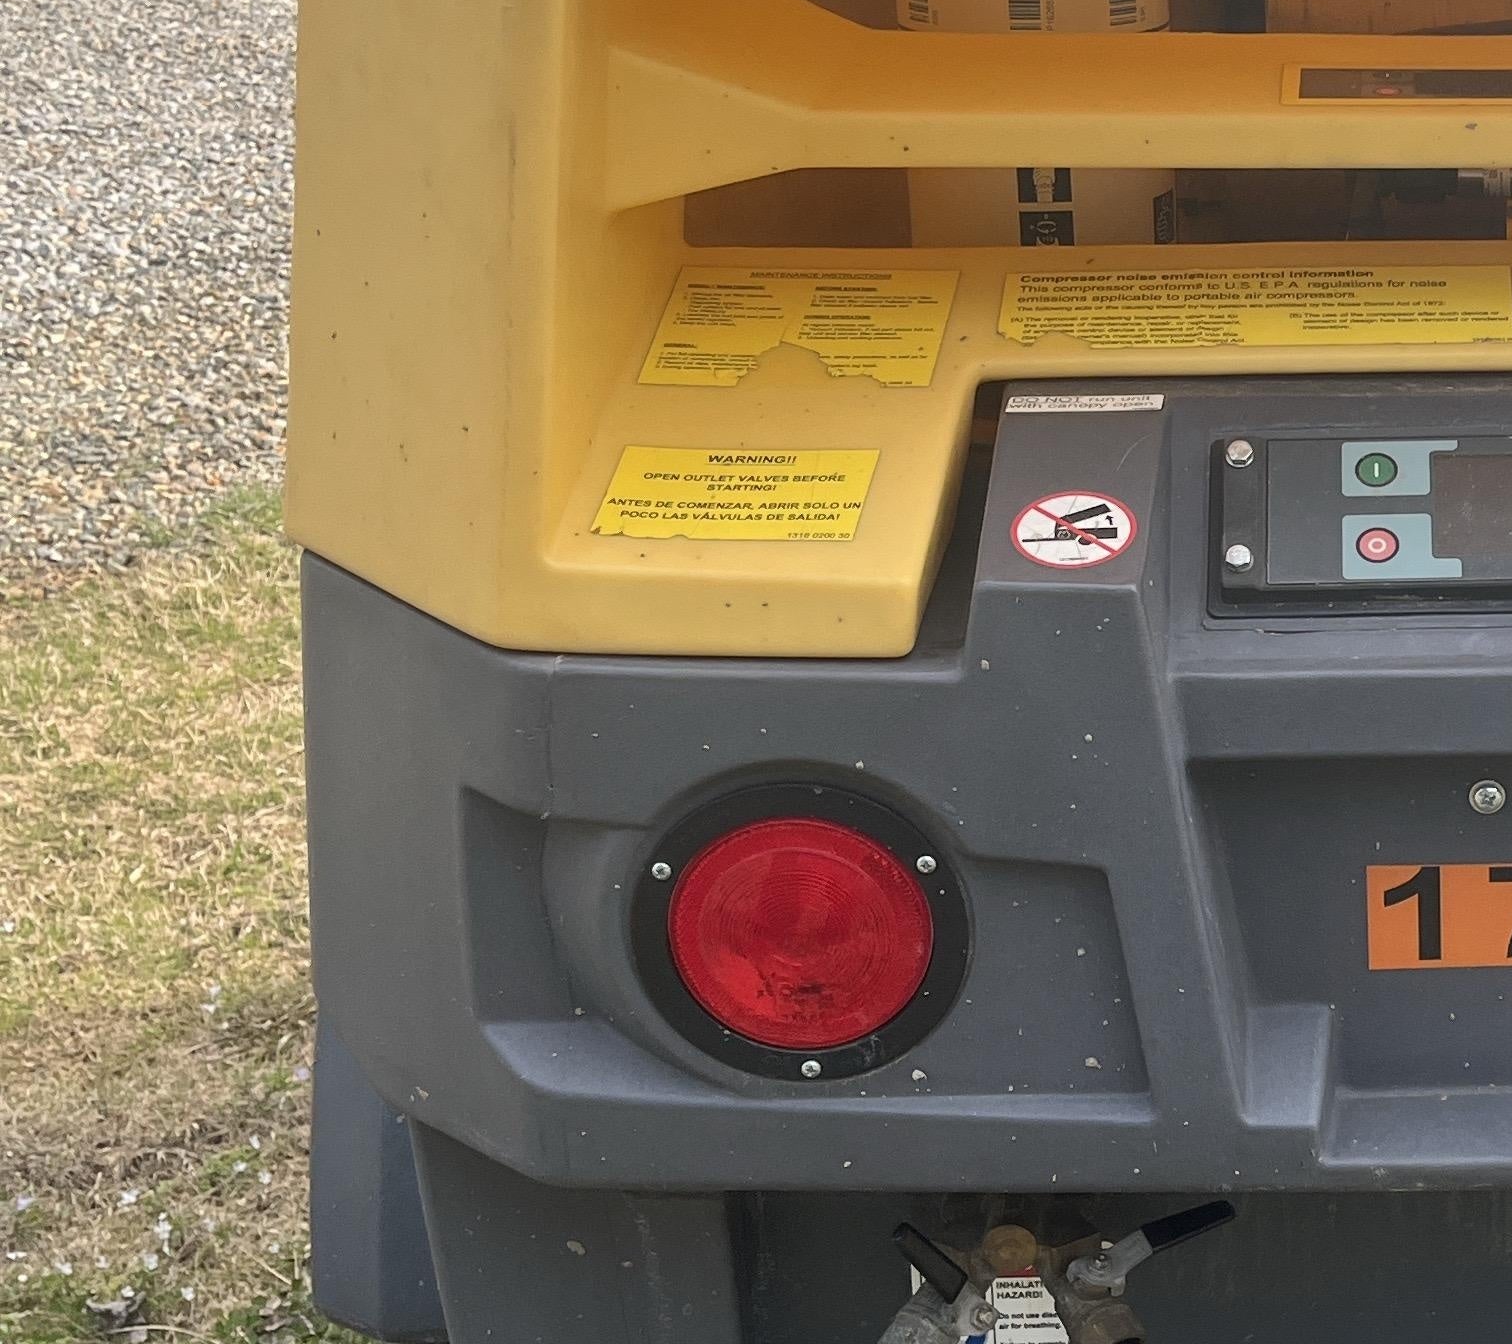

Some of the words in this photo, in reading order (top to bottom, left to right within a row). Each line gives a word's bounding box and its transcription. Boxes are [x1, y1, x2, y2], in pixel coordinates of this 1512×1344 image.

[1020, 274, 1113, 284] Compressor
[1116, 273, 1157, 281] noise
[1232, 271, 1284, 279] control
[1020, 285, 1049, 293] This
[1052, 285, 1135, 294] compressor
[707, 454, 798, 465] WARNING!!
[643, 472, 681, 482] OPEN
[683, 473, 736, 483] OUTLET
[738, 474, 790, 483] VALVES
[792, 474, 847, 483] BEFORE
[606, 497, 653, 508] ANTES
[654, 500, 674, 509] DE
[758, 501, 800, 511] ABRIR
[843, 501, 862, 510] UN
[620, 510, 659, 520] POCO
[661, 511, 689, 521] LAS
[692, 511, 763, 521] VÁLVULAS
[765, 513, 785, 522] DE
[996, 1290, 1044, 1299] HAZARD!
